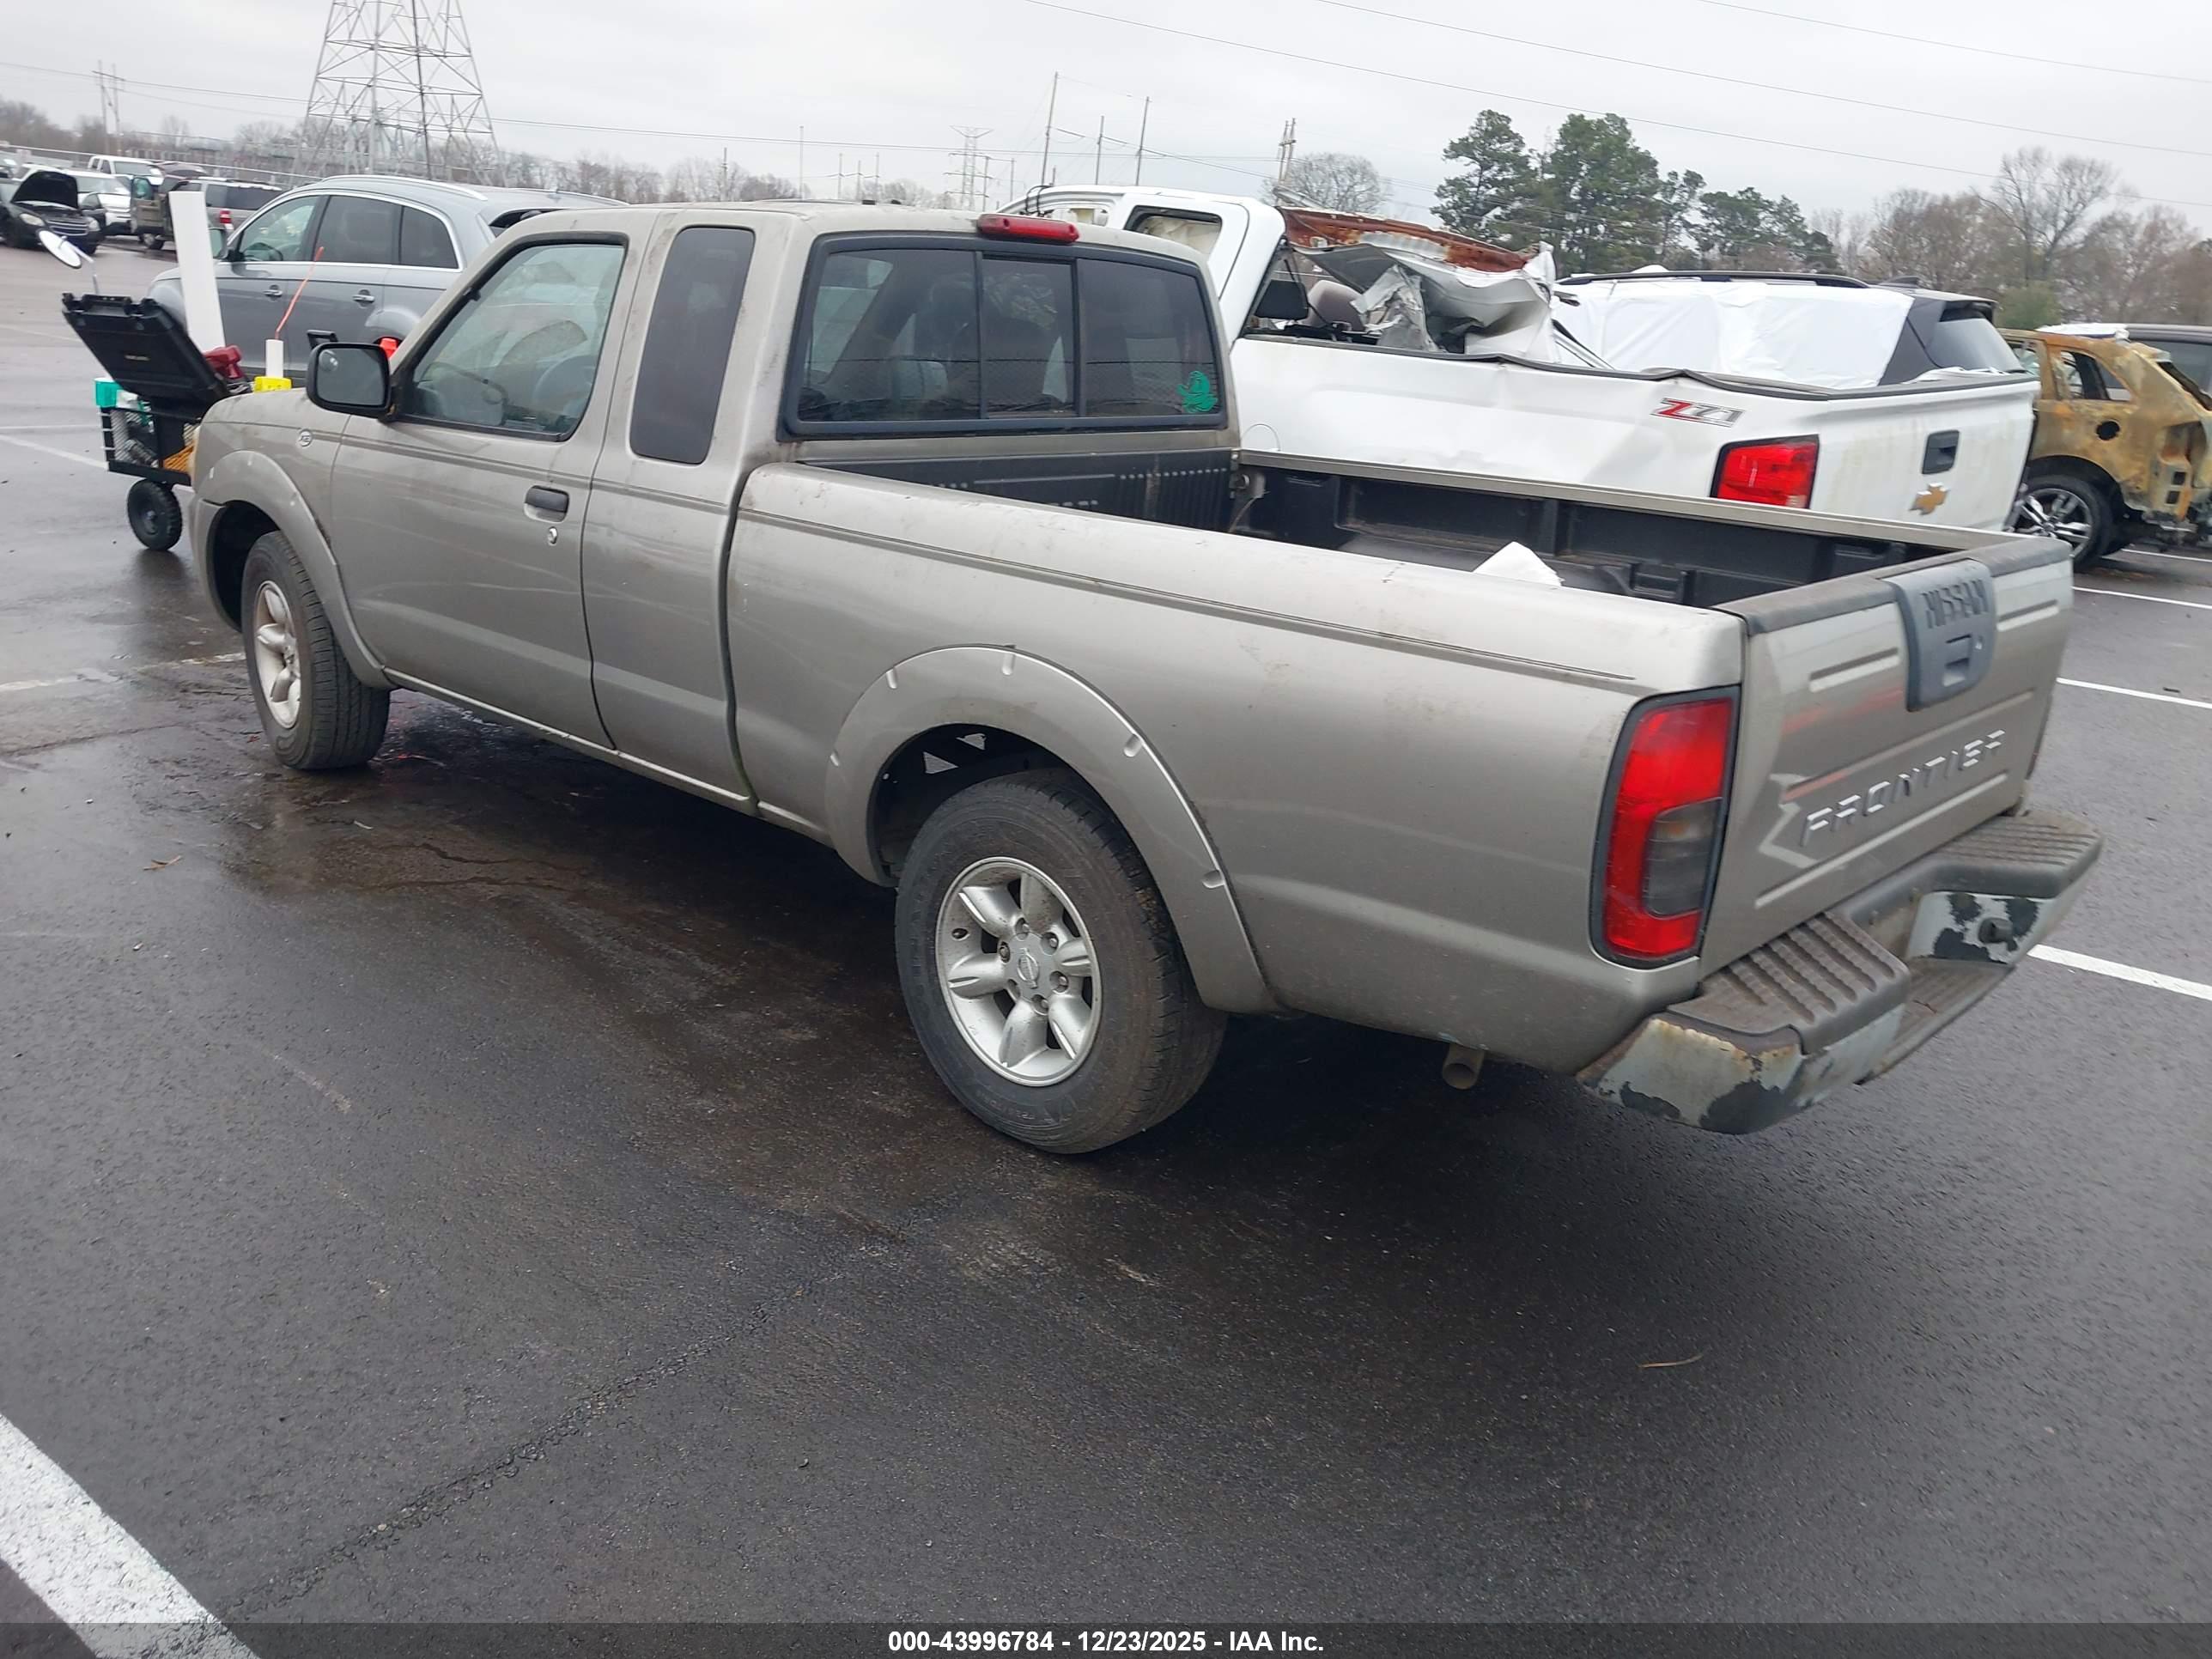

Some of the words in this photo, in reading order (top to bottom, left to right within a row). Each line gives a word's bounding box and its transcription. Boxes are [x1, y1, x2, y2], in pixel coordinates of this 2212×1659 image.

[1650, 397, 1746, 428] Z71
[1920, 579, 1989, 629] NISSAN
[1800, 729, 2006, 848] FRONTIER
